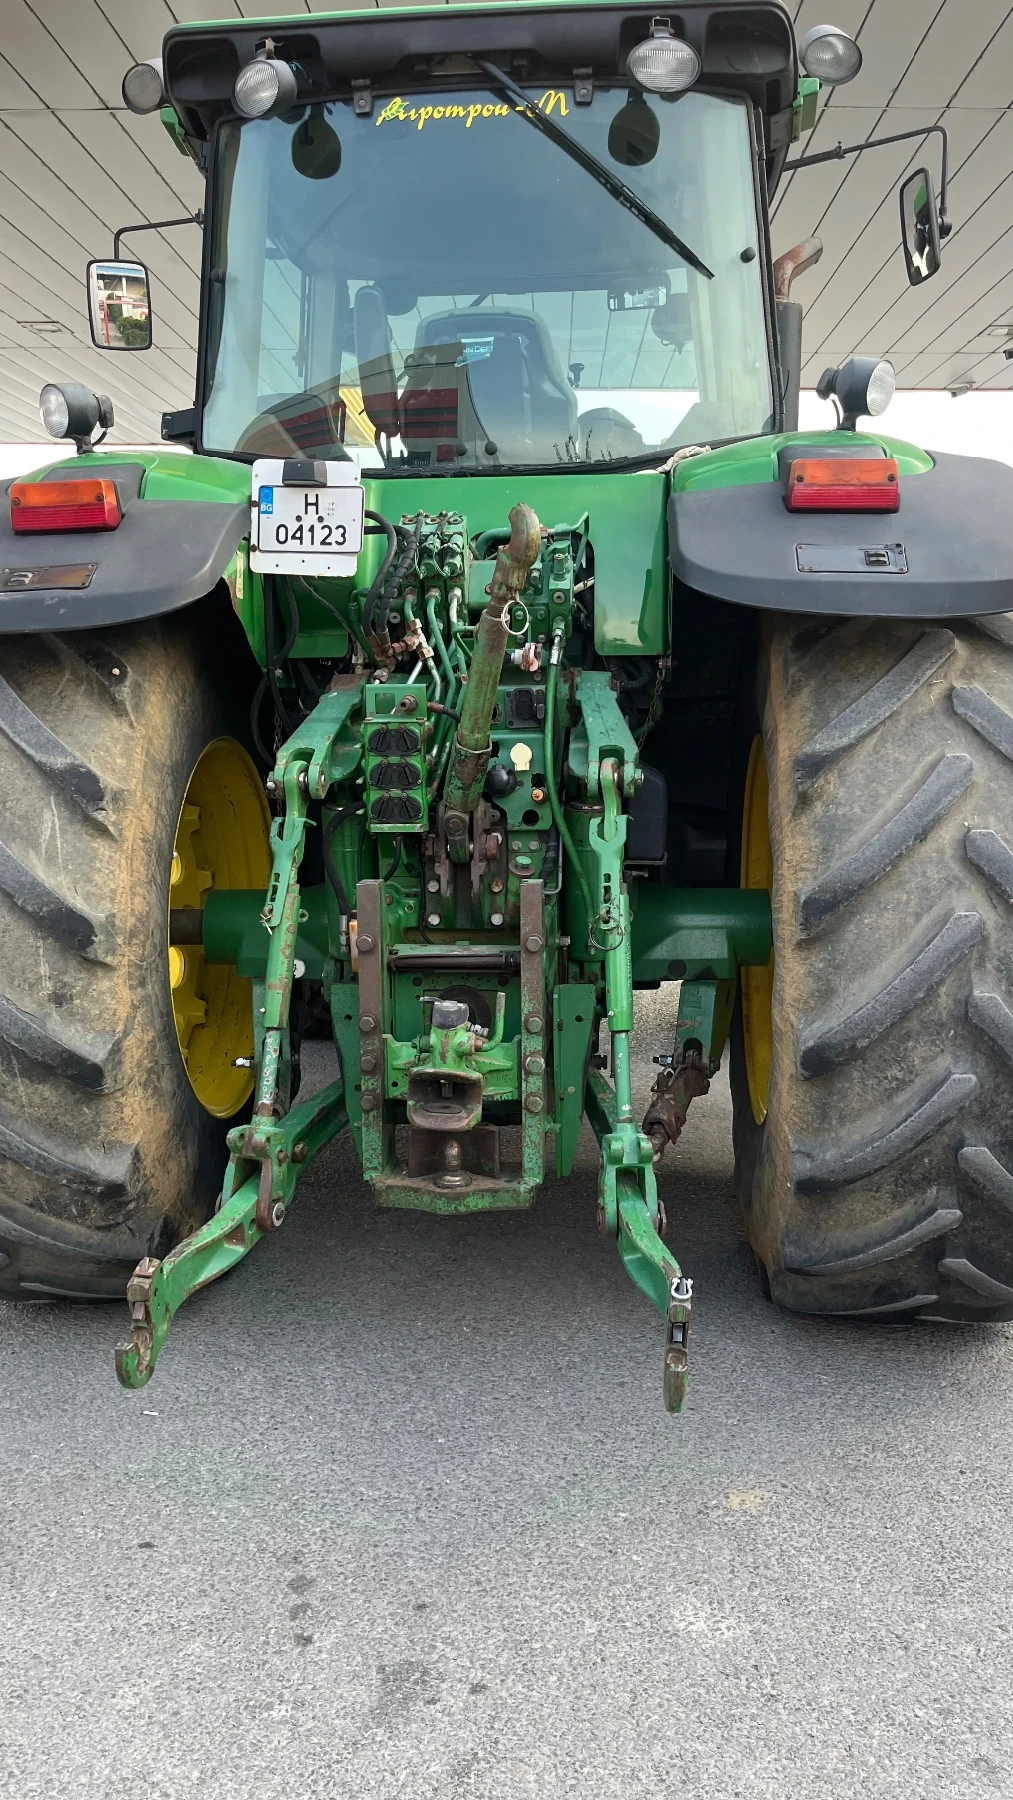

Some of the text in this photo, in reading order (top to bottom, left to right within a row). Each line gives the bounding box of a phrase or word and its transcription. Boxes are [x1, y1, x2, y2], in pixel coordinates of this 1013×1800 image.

[260, 504, 273, 512] BG
[304, 493, 319, 515] H
[275, 523, 347, 546] 04123
